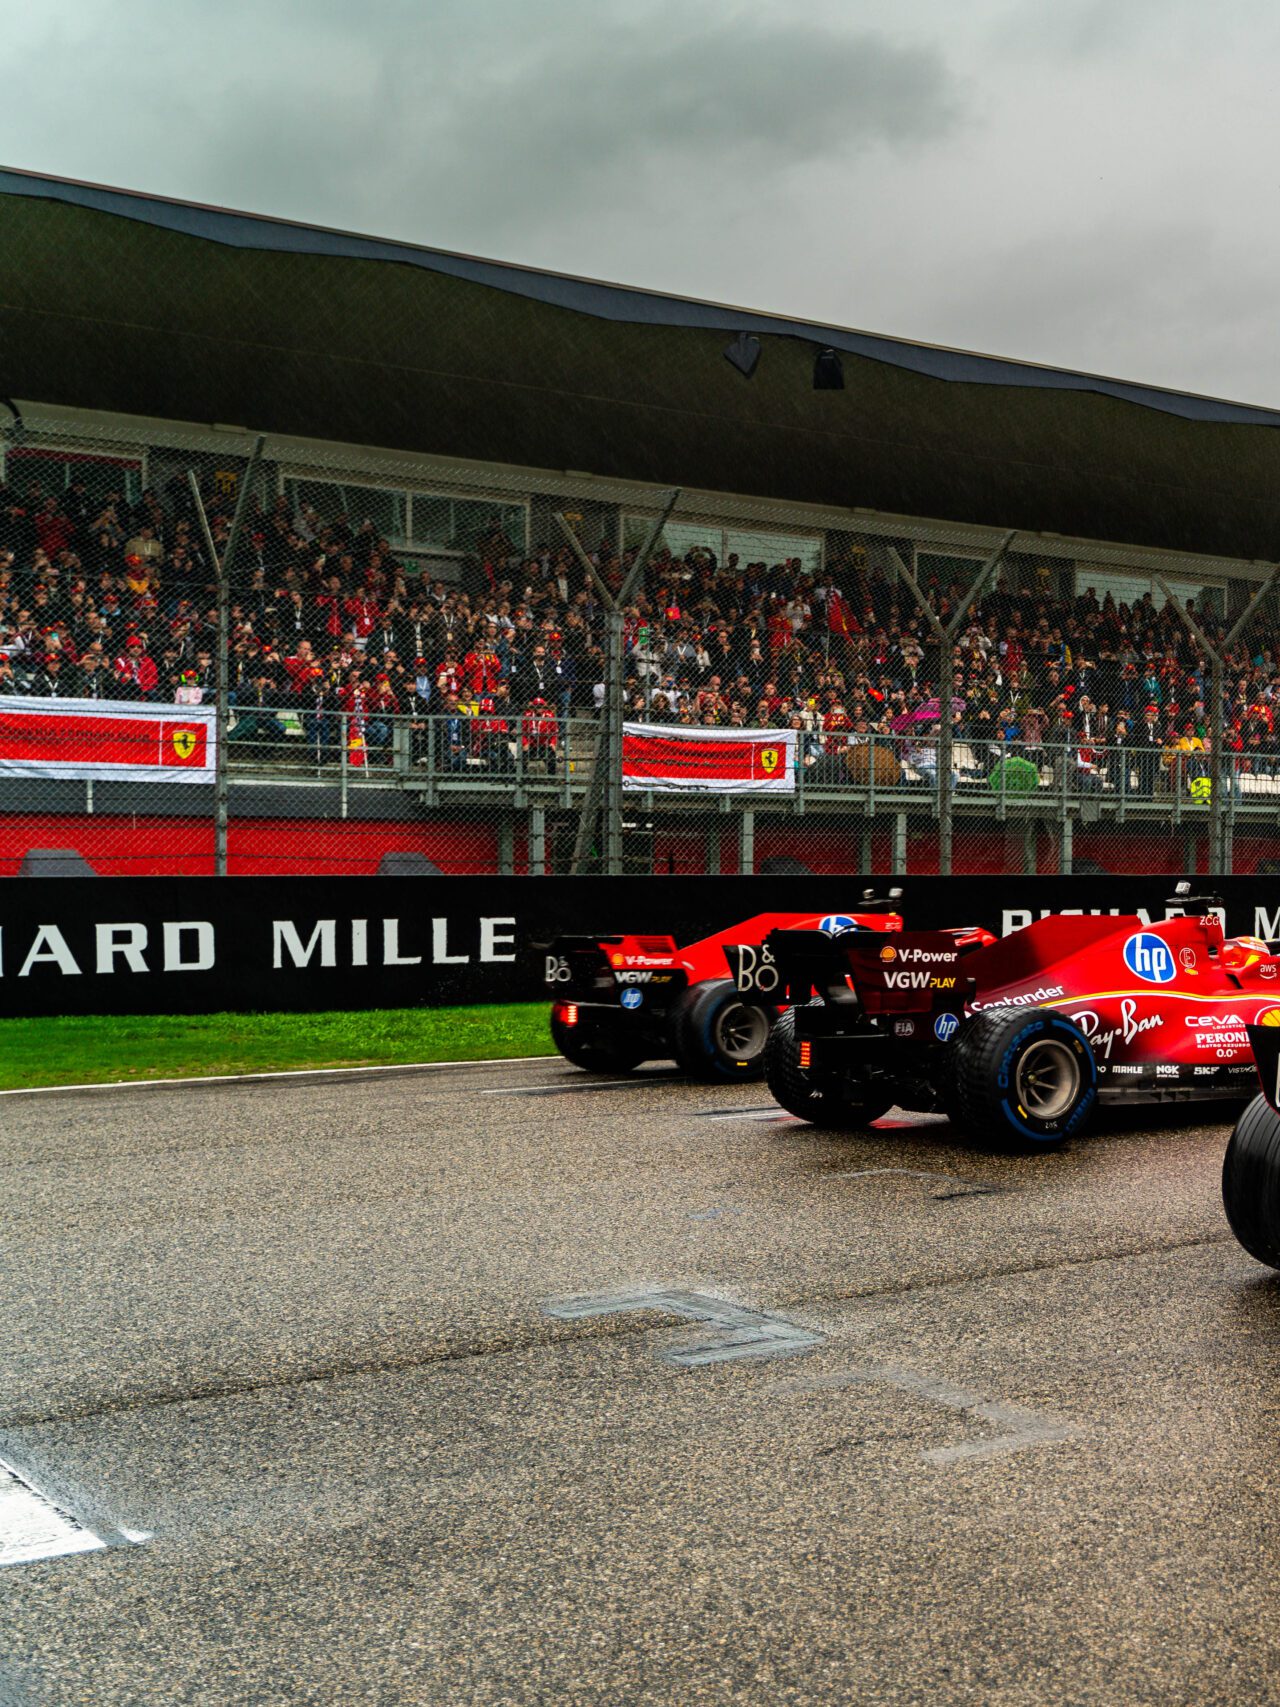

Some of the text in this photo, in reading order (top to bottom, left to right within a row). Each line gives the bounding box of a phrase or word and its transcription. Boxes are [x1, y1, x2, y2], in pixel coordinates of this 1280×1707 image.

[0, 916, 517, 977] ARD MILLE
[625, 955, 674, 966] V-Power
[898, 948, 958, 963] V-Power
[1135, 933, 1167, 982] hp
[614, 971, 653, 983] VGW
[883, 971, 956, 989] VGW PLAY
[938, 1013, 960, 1041] hp
[1195, 1031, 1250, 1044] PERONI
[1112, 1065, 1143, 1074] MAHLE
[1156, 1064, 1180, 1075] NGK
[1193, 1066, 1220, 1075] SKF
